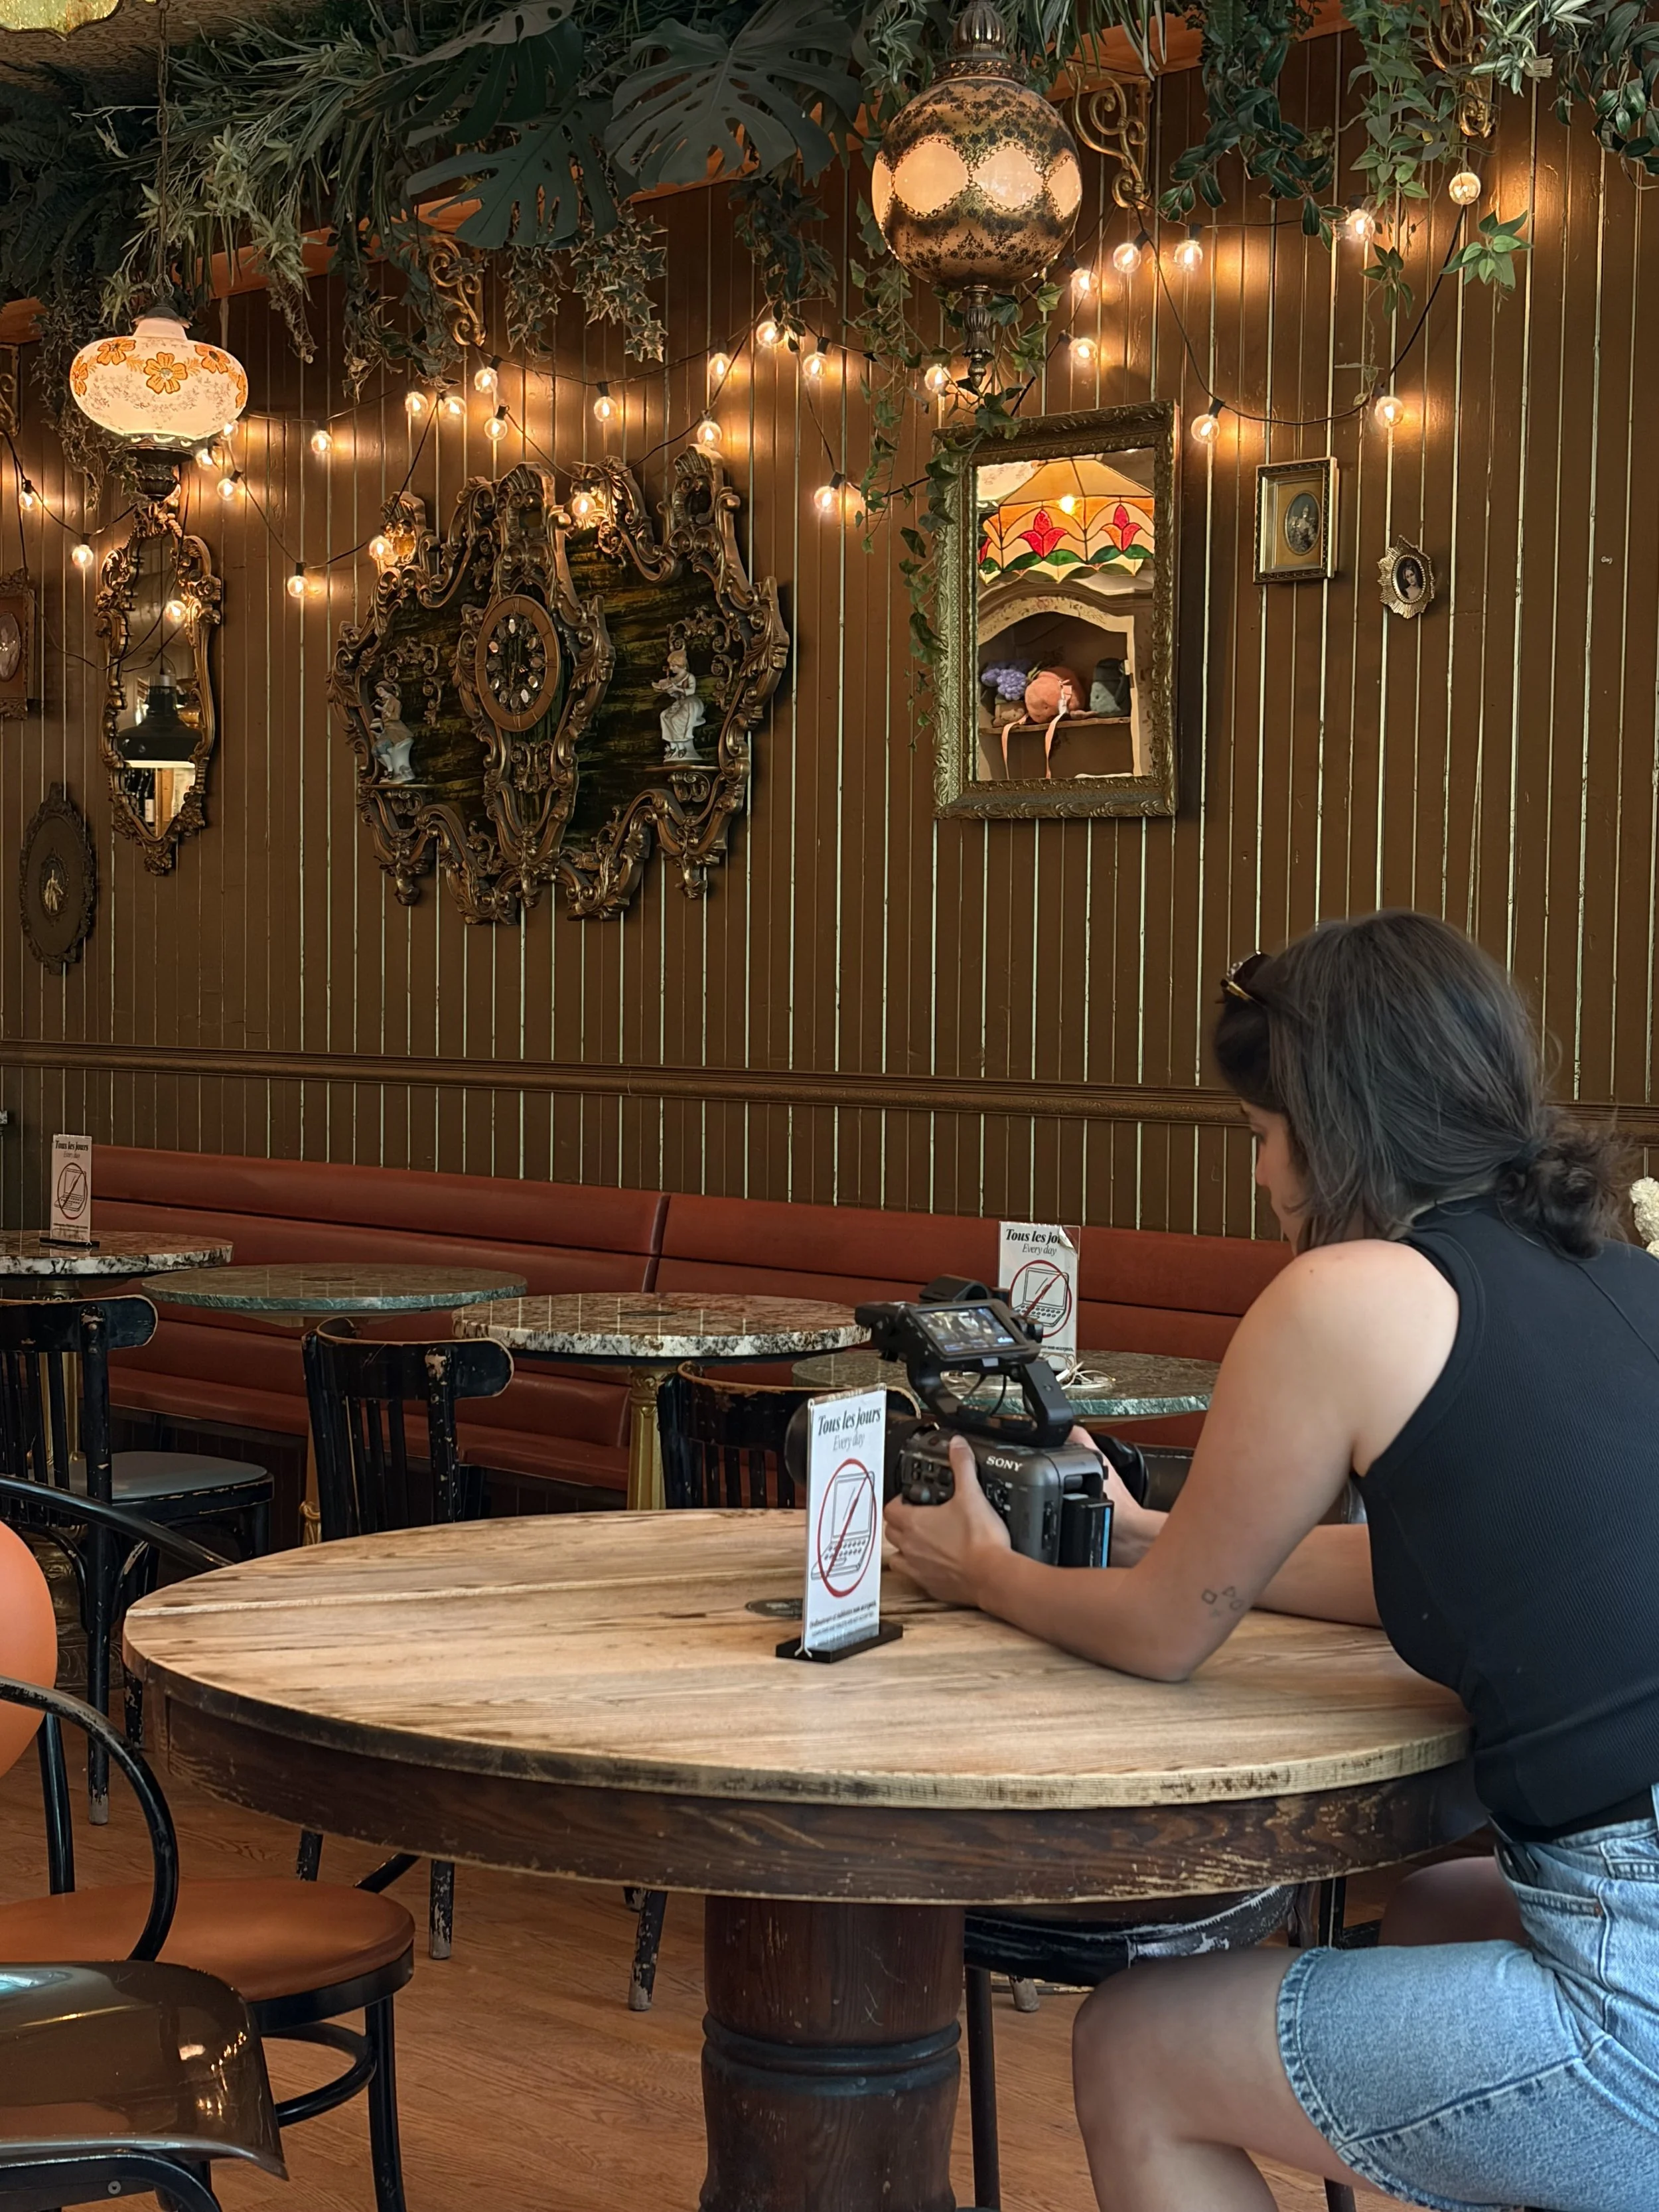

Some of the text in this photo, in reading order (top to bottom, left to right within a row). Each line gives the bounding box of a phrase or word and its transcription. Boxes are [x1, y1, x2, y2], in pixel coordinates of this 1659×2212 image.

[1006, 1228, 1030, 1242] Tous
[1031, 1230, 1046, 1243] les
[1022, 1243, 1058, 1257] Every day
[818, 1406, 881, 1436] Tous les jours
[833, 1432, 865, 1452] Every day
[986, 1455, 1023, 1472] SONY
